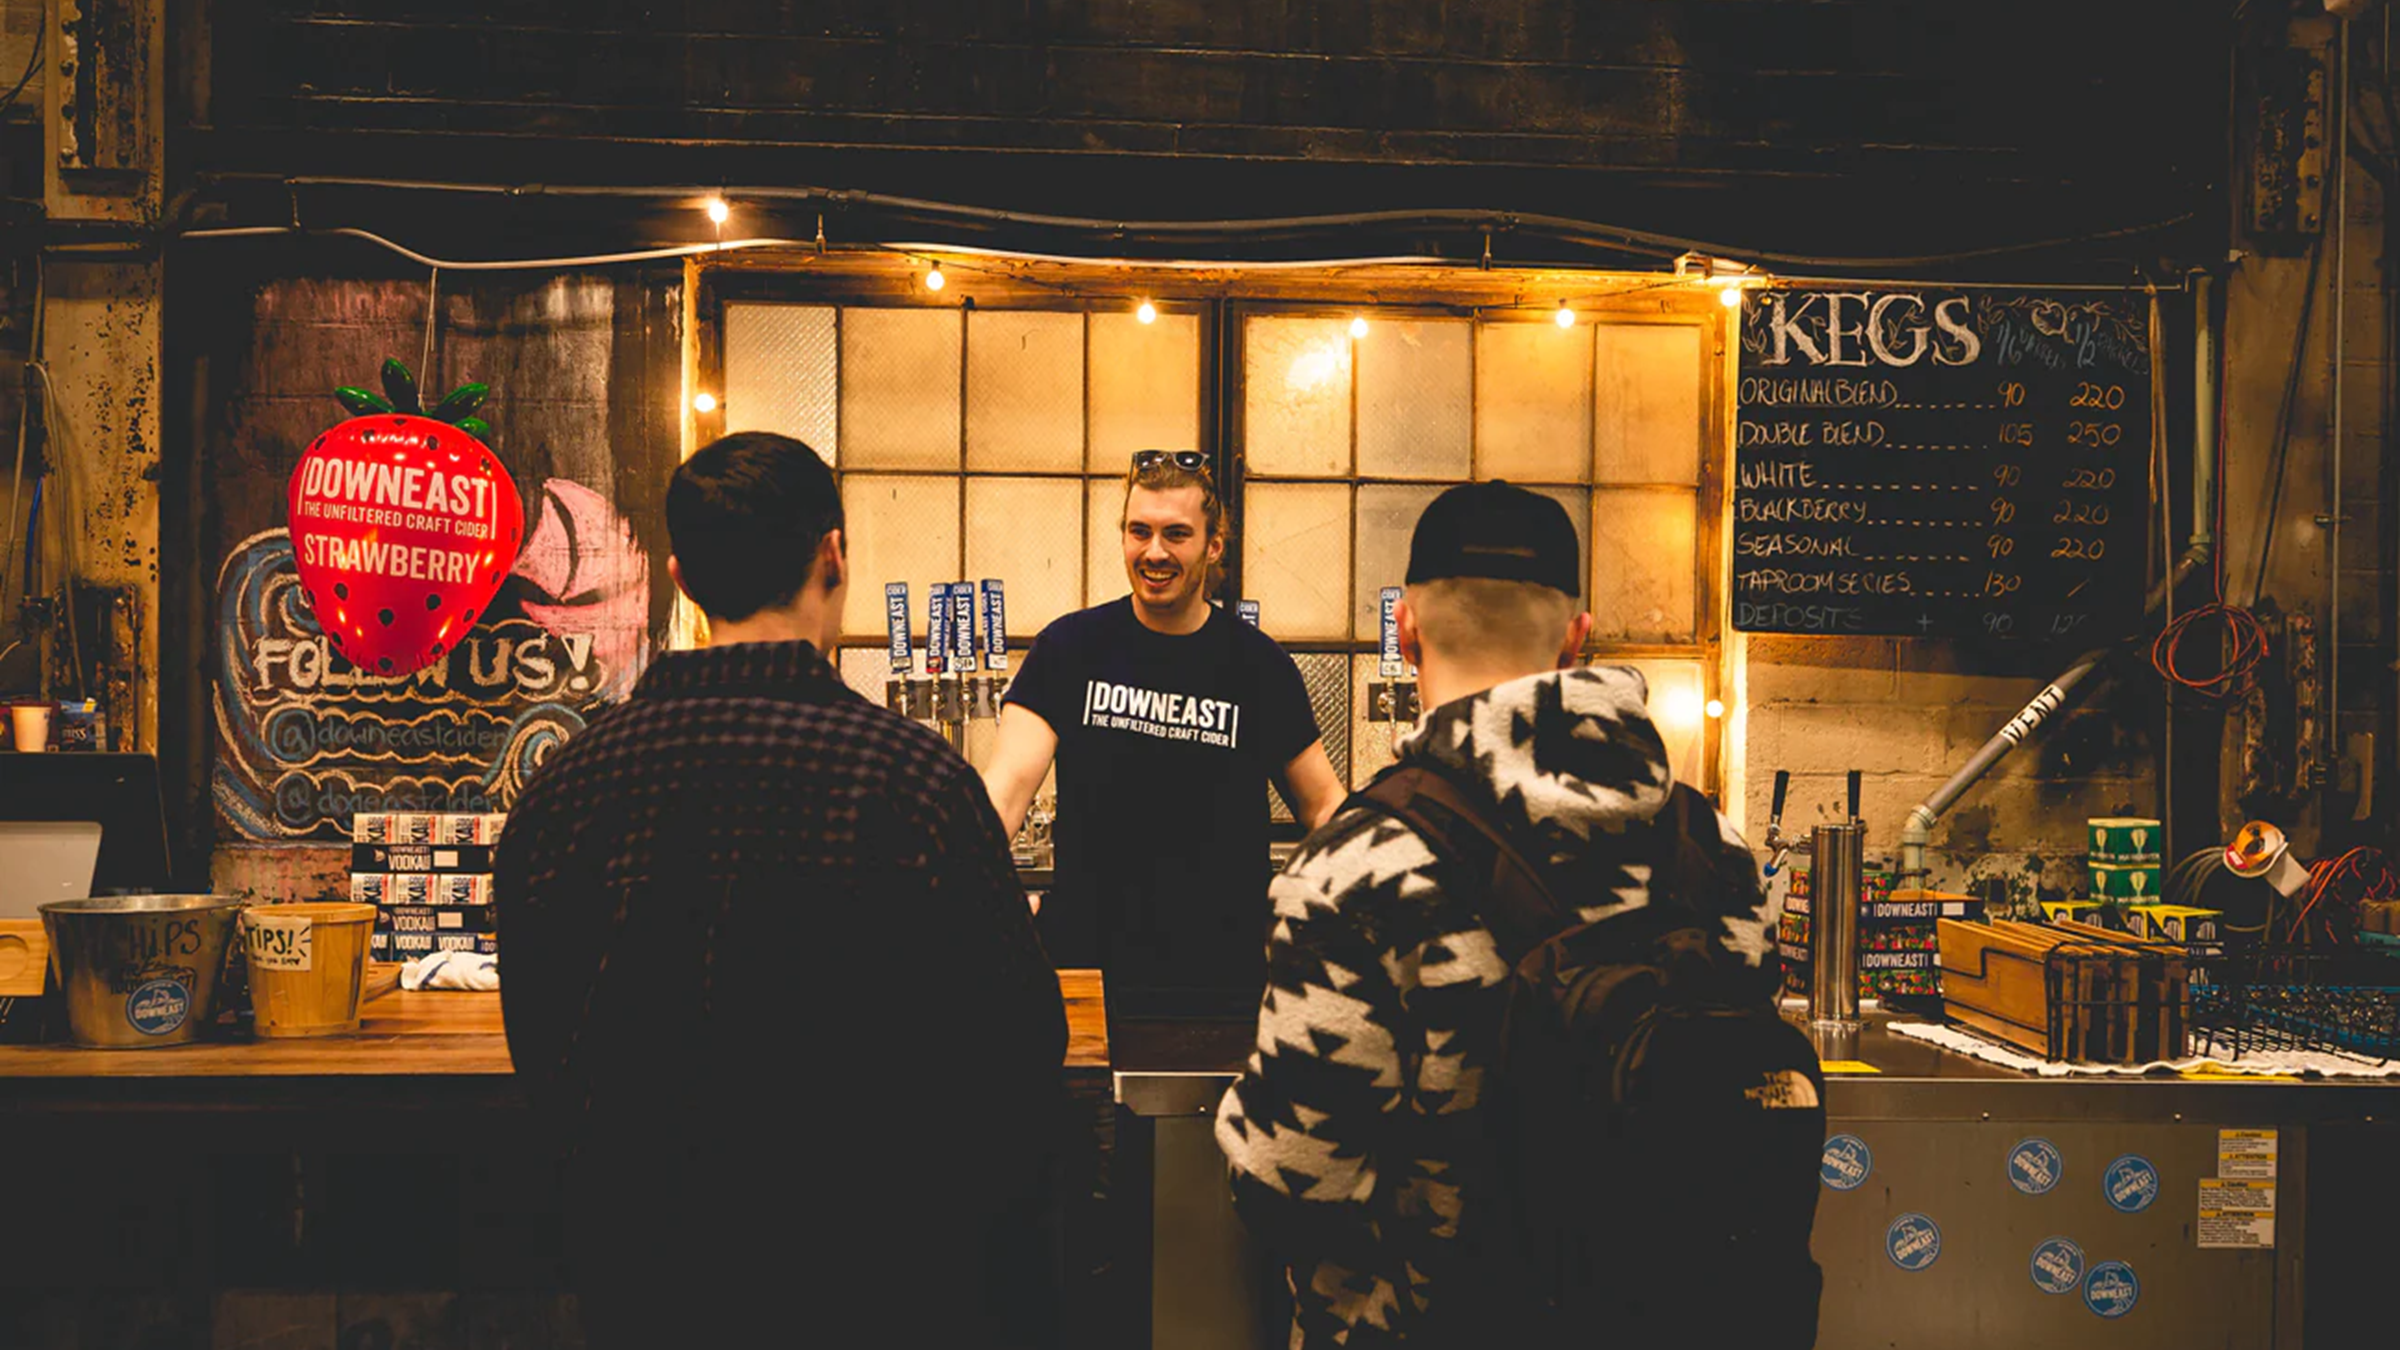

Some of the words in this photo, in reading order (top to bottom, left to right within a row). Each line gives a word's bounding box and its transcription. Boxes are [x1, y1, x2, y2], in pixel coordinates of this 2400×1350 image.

[1761, 290, 1982, 368] KEGS
[1998, 382, 2026, 408] 90
[2069, 382, 2125, 410] 220
[1739, 421, 1812, 447] DOUBLE
[1822, 421, 1885, 447] BLEND
[1999, 422, 2034, 446] 105
[2067, 421, 2122, 448] 250
[304, 456, 489, 519] DOWNEAST
[1740, 461, 1817, 489] WHITE
[1993, 464, 2022, 488] 90
[2062, 467, 2115, 490] 220
[303, 500, 321, 519] THE
[323, 504, 403, 528] UNFILTERED
[406, 513, 452, 535] CRAFT
[454, 519, 489, 540] CIDER
[1740, 497, 1867, 525] BLACKBERRY
[1990, 497, 2016, 525] 90
[2053, 499, 2109, 526] 220
[303, 533, 481, 585] STRAWBERRY
[1736, 533, 1859, 557] SEASONAL
[1987, 535, 2014, 560] 90
[2050, 537, 2105, 561] 220
[1736, 569, 1834, 594] TAPROOM
[1983, 571, 2022, 594] 130
[889, 596, 909, 658] DOWNEAST
[928, 597, 944, 658] DOWNEAST
[955, 596, 972, 657] DOWNEAST
[989, 592, 1005, 654] DOWNEAST
[1982, 614, 2013, 634] 90
[252, 635, 451, 691] FOLW
[1092, 680, 1232, 731] DOWNEAST
[2003, 687, 2061, 742] VENT
[1091, 713, 1110, 728] THE
[1110, 715, 1168, 739] UNFILTERED
[1168, 726, 1199, 742] CRAFT
[1200, 729, 1230, 747] CIDER
[1876, 903, 1933, 918] DOWNEAST
[1865, 953, 1926, 968] DOWNEAST
